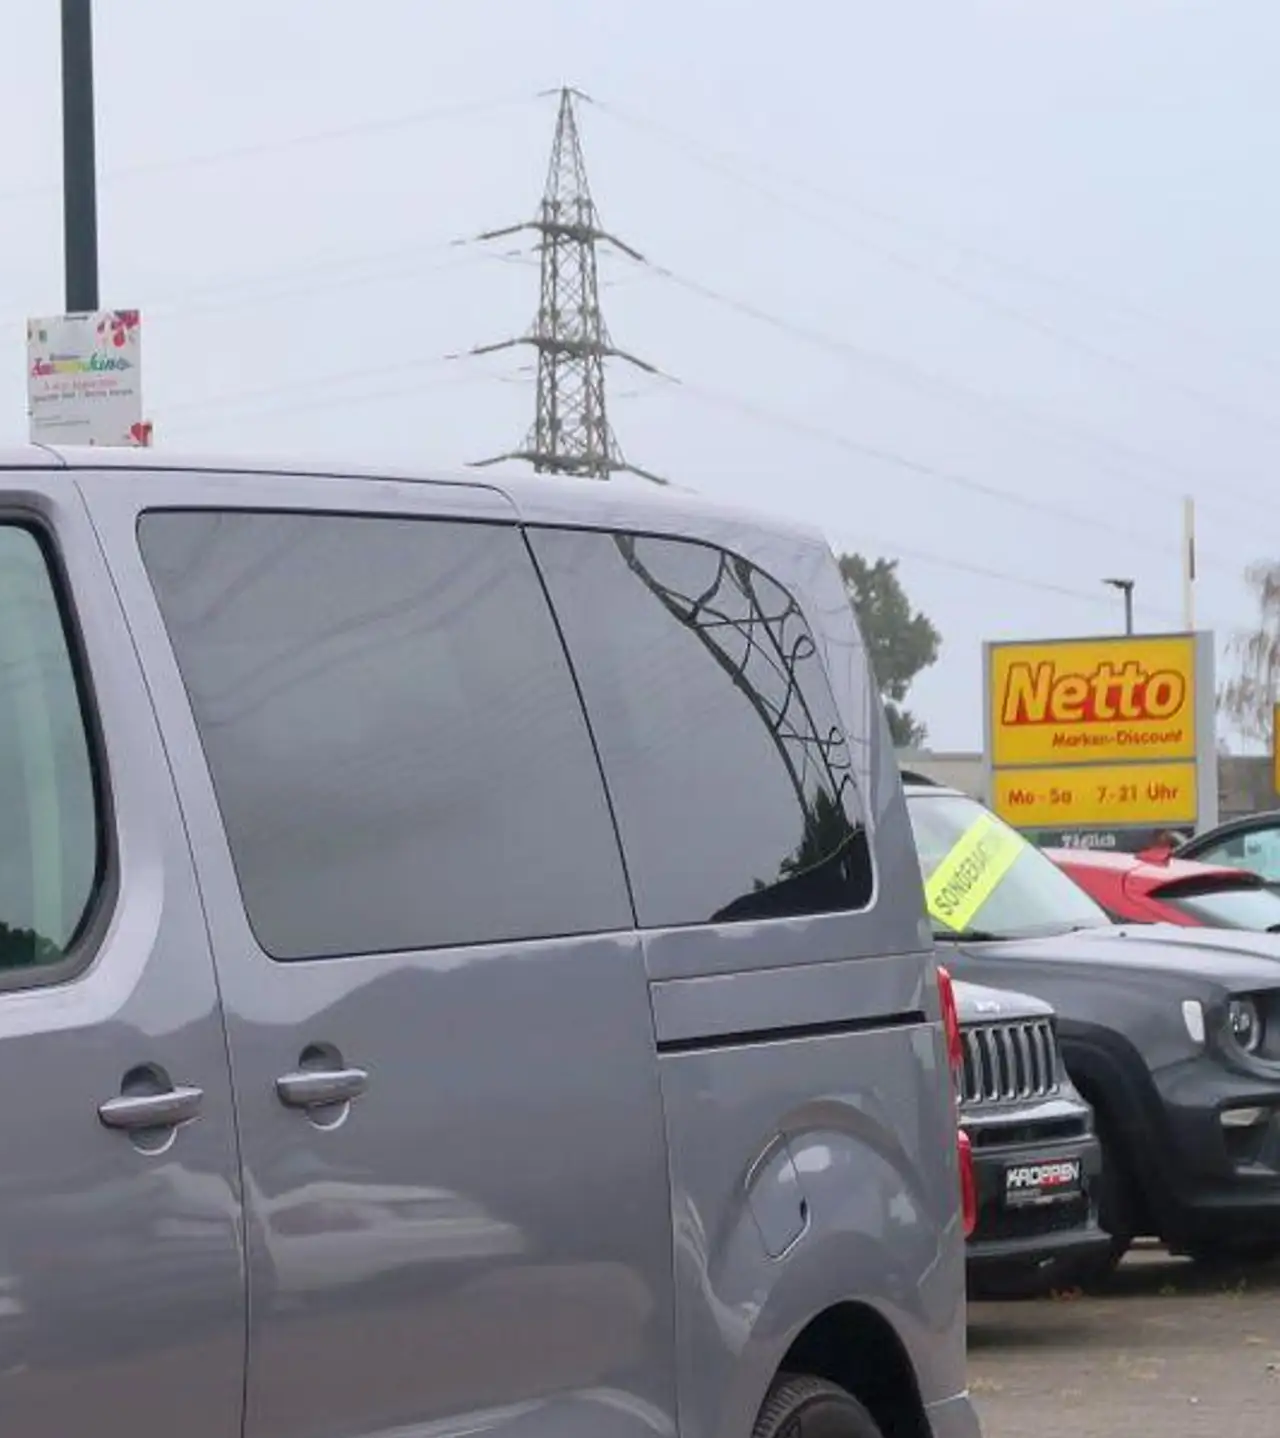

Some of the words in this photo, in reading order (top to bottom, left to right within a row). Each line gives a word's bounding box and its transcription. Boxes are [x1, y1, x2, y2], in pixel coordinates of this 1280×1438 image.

[1002, 660, 1186, 727] Netto
[1147, 780, 1178, 802] Uhr
[1006, 1161, 1079, 1189] KROPPEN
